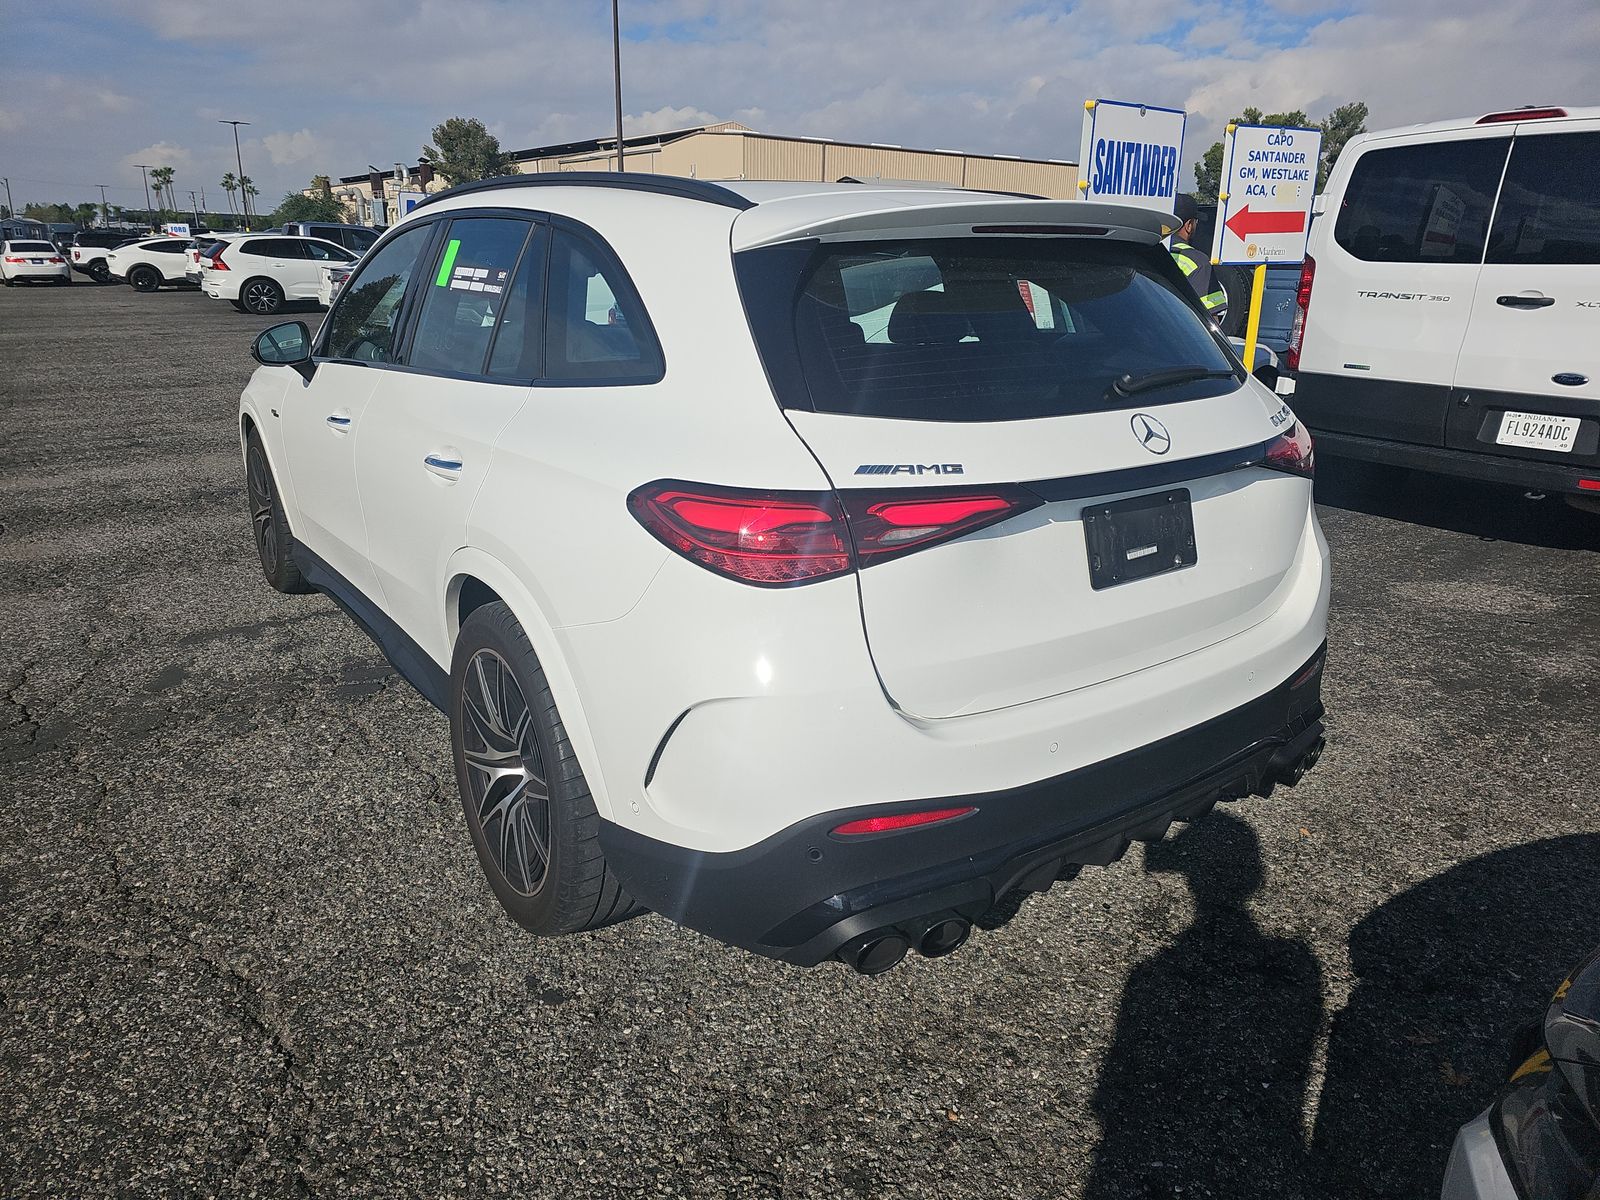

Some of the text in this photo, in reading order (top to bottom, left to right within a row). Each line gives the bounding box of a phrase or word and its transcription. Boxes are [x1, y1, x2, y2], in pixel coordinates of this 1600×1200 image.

[1267, 133, 1294, 147] CAPO
[1248, 150, 1306, 164] SANTANDER
[1092, 138, 1177, 198] SANTANDER
[1239, 167, 1310, 181] GM, WESTLAKE
[1245, 184, 1268, 198] ACA,
[1357, 290, 1427, 301] TRANSIT
[1524, 414, 1558, 423] INDIANA
[1505, 420, 1571, 441] FL924ADC
[890, 463, 965, 475] AMG
